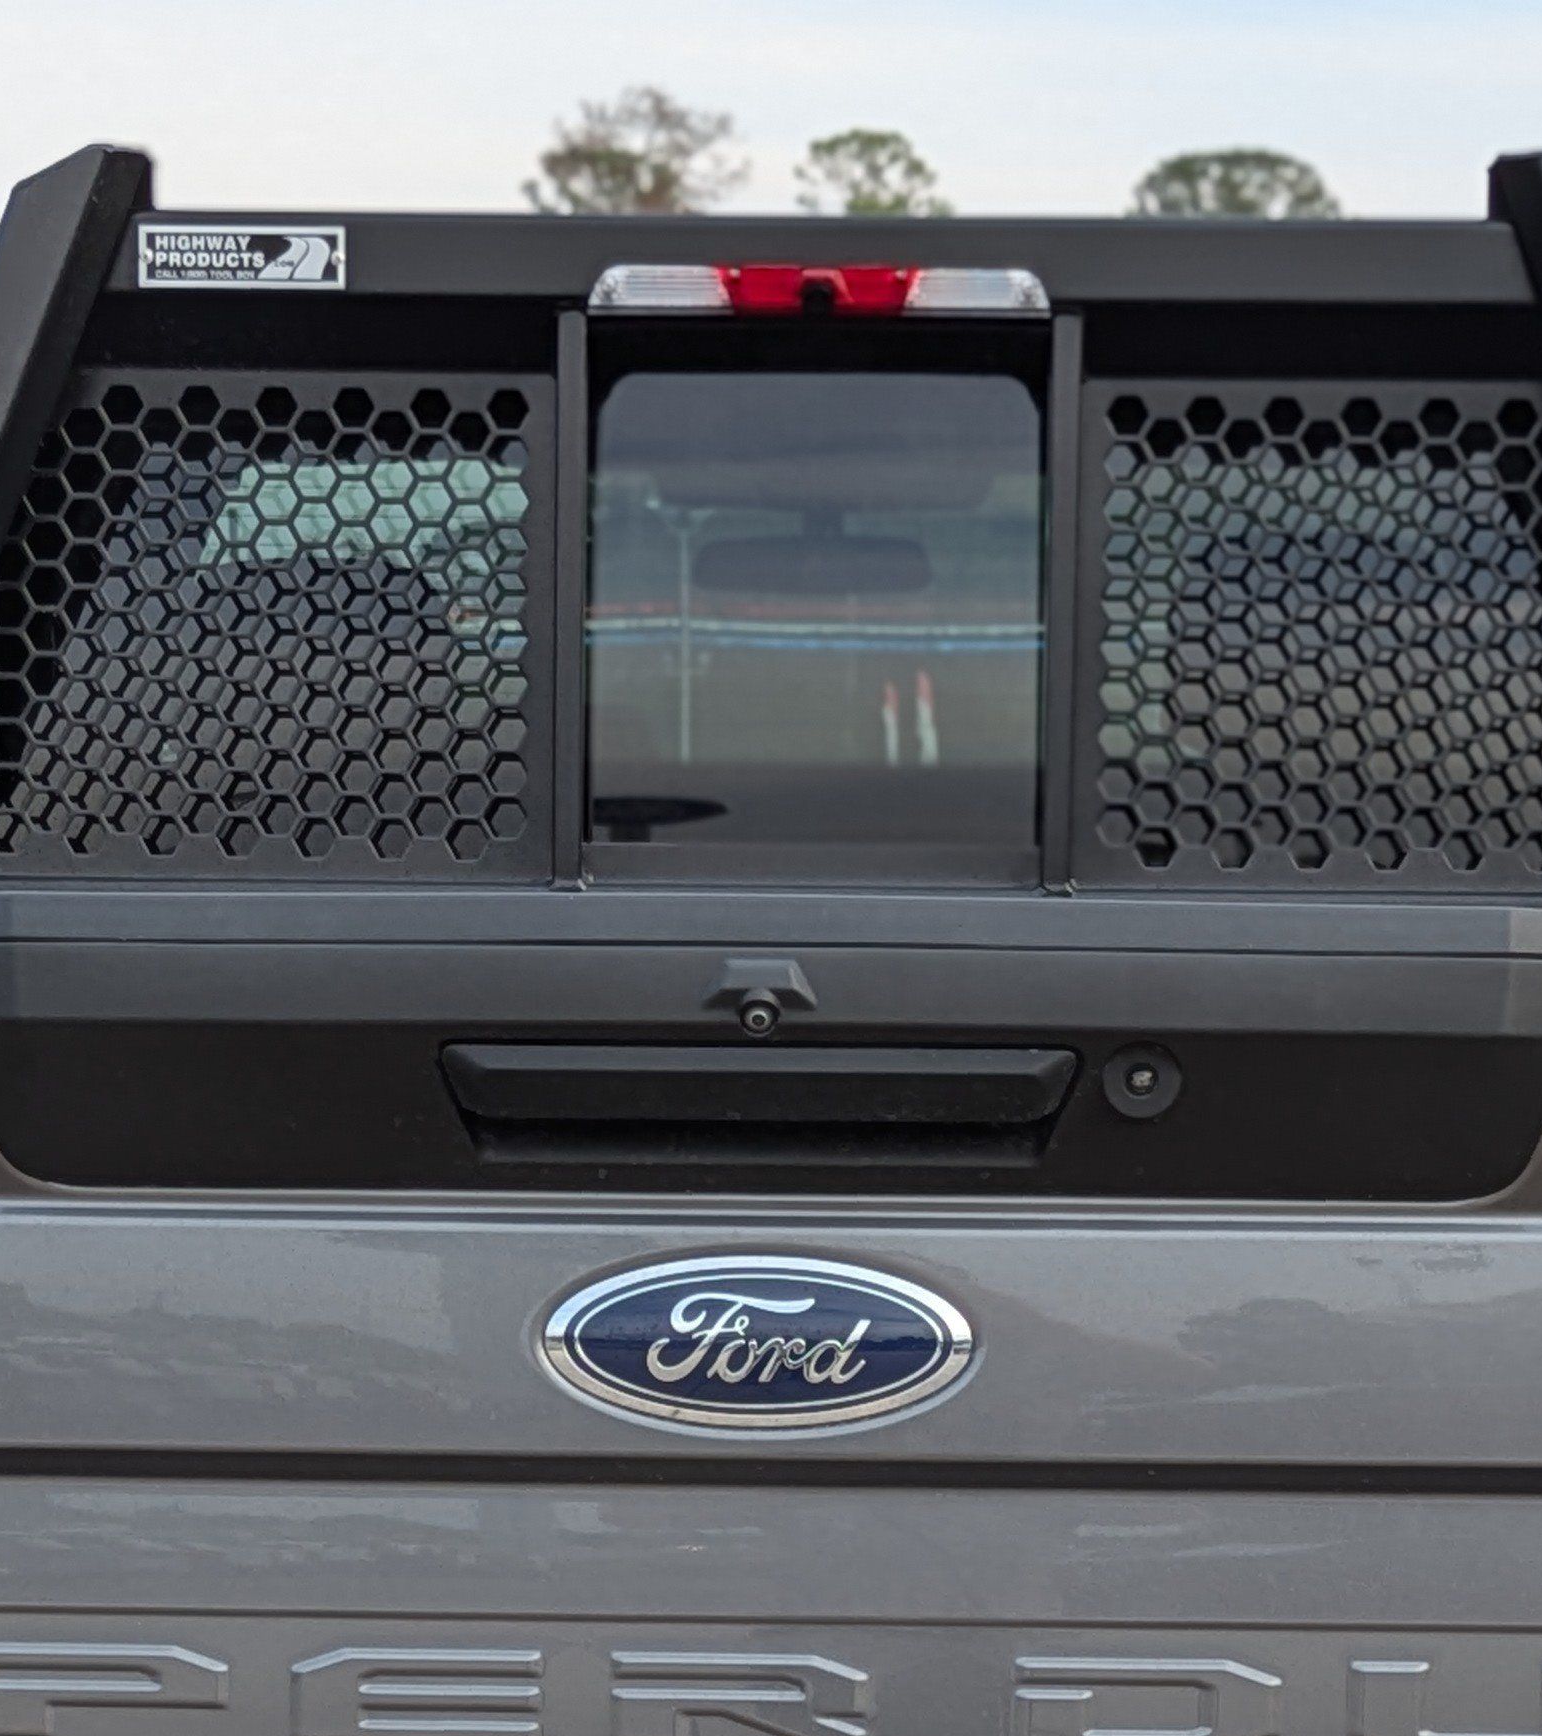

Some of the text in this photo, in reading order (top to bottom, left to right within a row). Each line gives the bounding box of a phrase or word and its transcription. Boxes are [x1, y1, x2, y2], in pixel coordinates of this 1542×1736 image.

[154, 235, 251, 251] HIGHWAY
[154, 252, 266, 268] PRODUCTS
[646, 1292, 871, 1384] Ford
